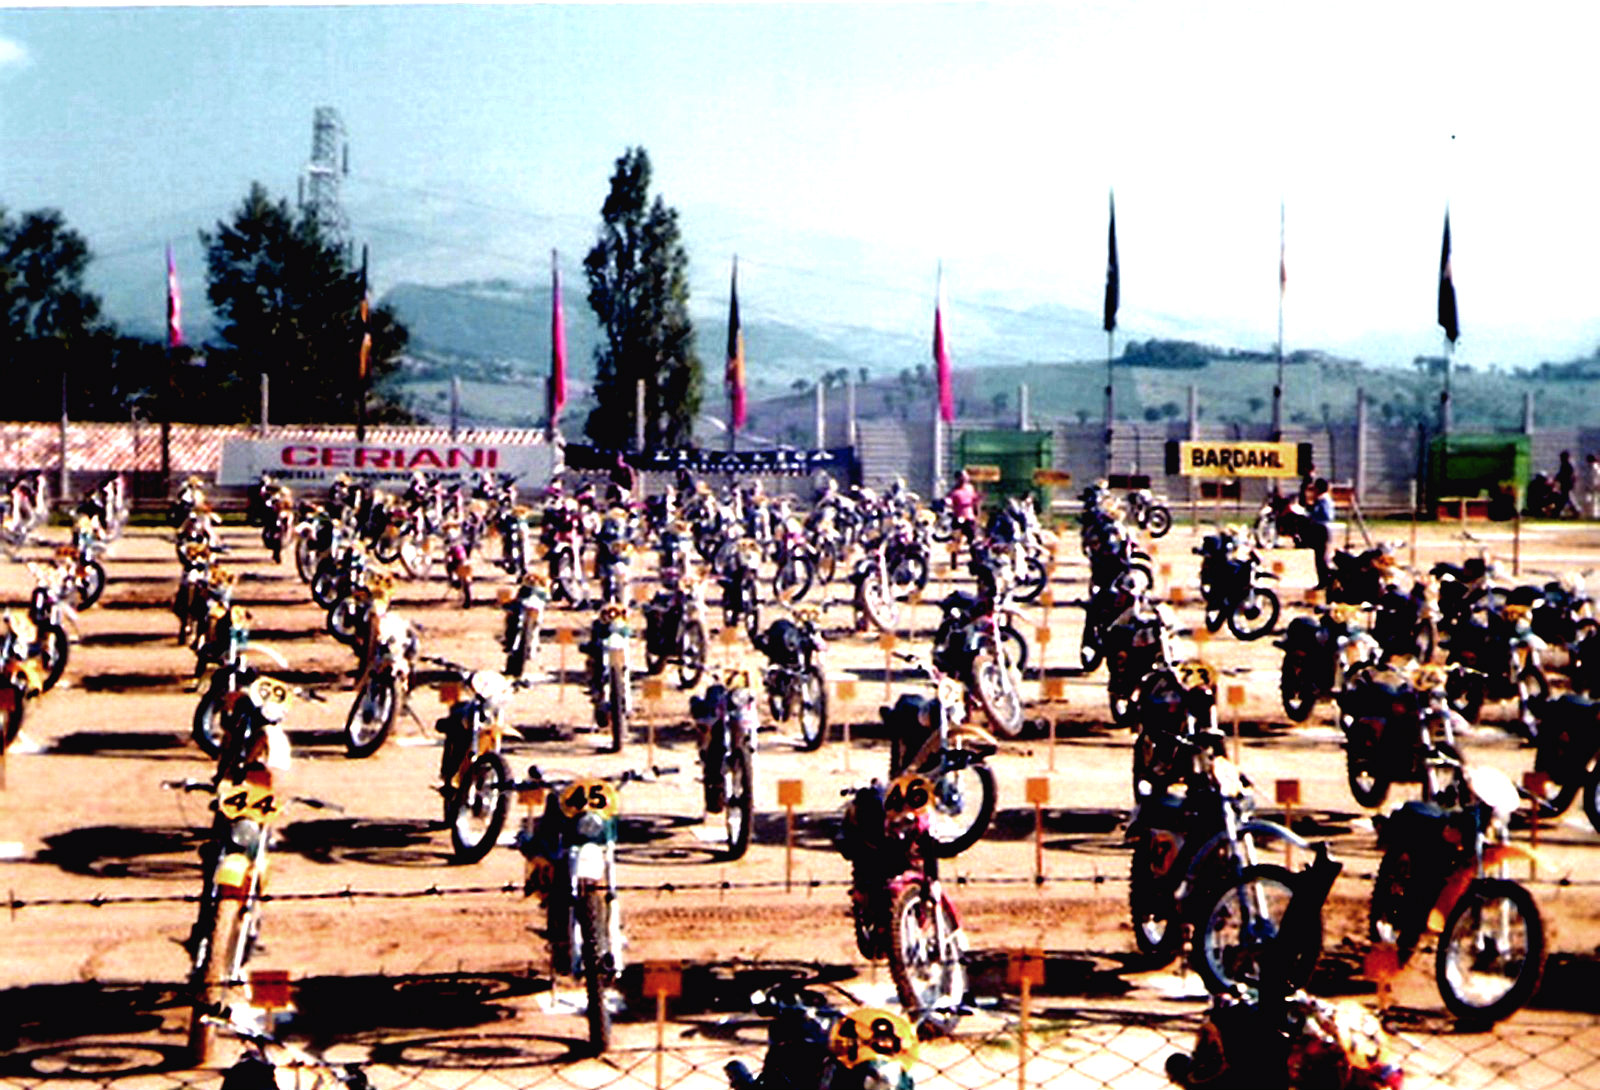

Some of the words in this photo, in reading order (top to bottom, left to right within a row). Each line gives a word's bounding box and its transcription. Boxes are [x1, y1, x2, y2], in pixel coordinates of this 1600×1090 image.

[281, 446, 498, 468] CERIANI
[1191, 448, 1284, 473] BARDAHL
[258, 681, 287, 703] 69
[223, 792, 277, 815] 44
[565, 785, 607, 811] 45
[884, 779, 928, 812] 46
